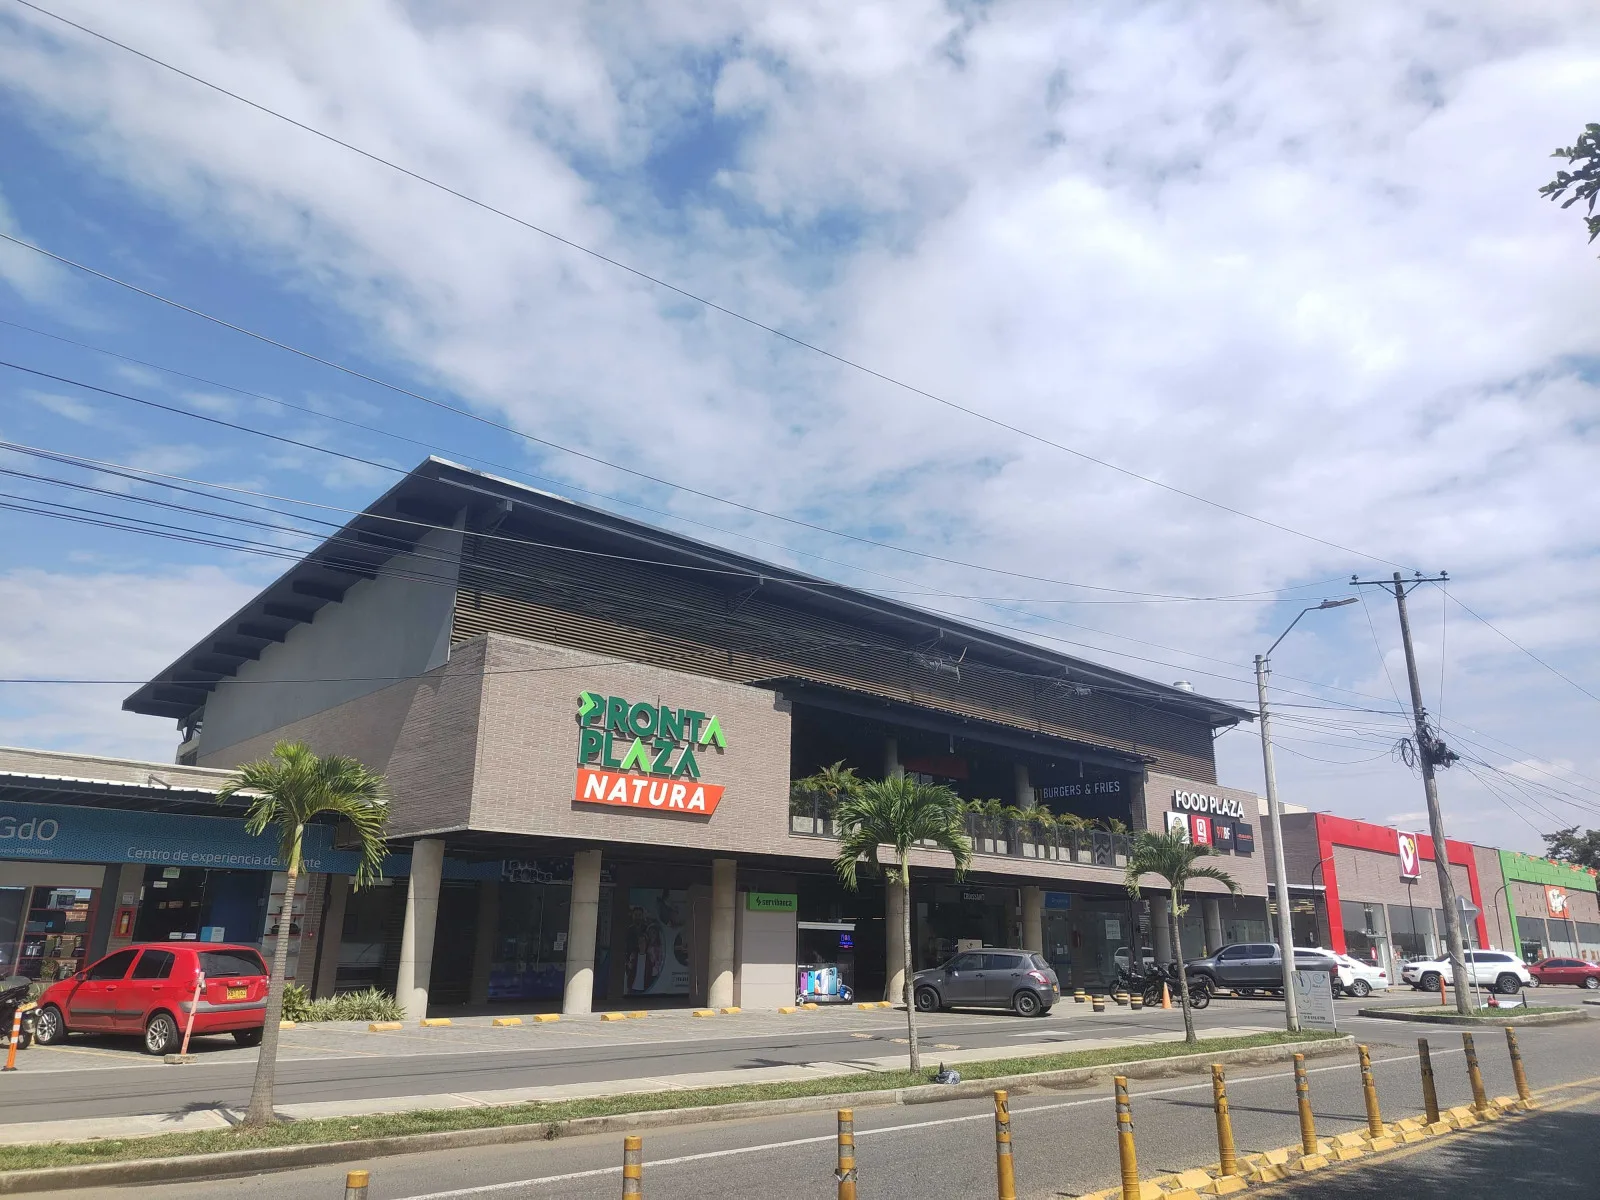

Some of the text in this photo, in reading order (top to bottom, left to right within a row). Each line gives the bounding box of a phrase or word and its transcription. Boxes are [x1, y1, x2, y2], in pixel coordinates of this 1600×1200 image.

[578, 690, 727, 748] PRONTA
[578, 728, 701, 778] PLAZA
[584, 774, 705, 811] NATURA
[1043, 781, 1120, 798] BURGERS & FRIES
[1175, 789, 1245, 818] FOOD PLAZA
[0, 816, 59, 841] GdO
[127, 846, 170, 861] Centro
[172, 849, 188, 861] de
[191, 851, 261, 867] experiencia
